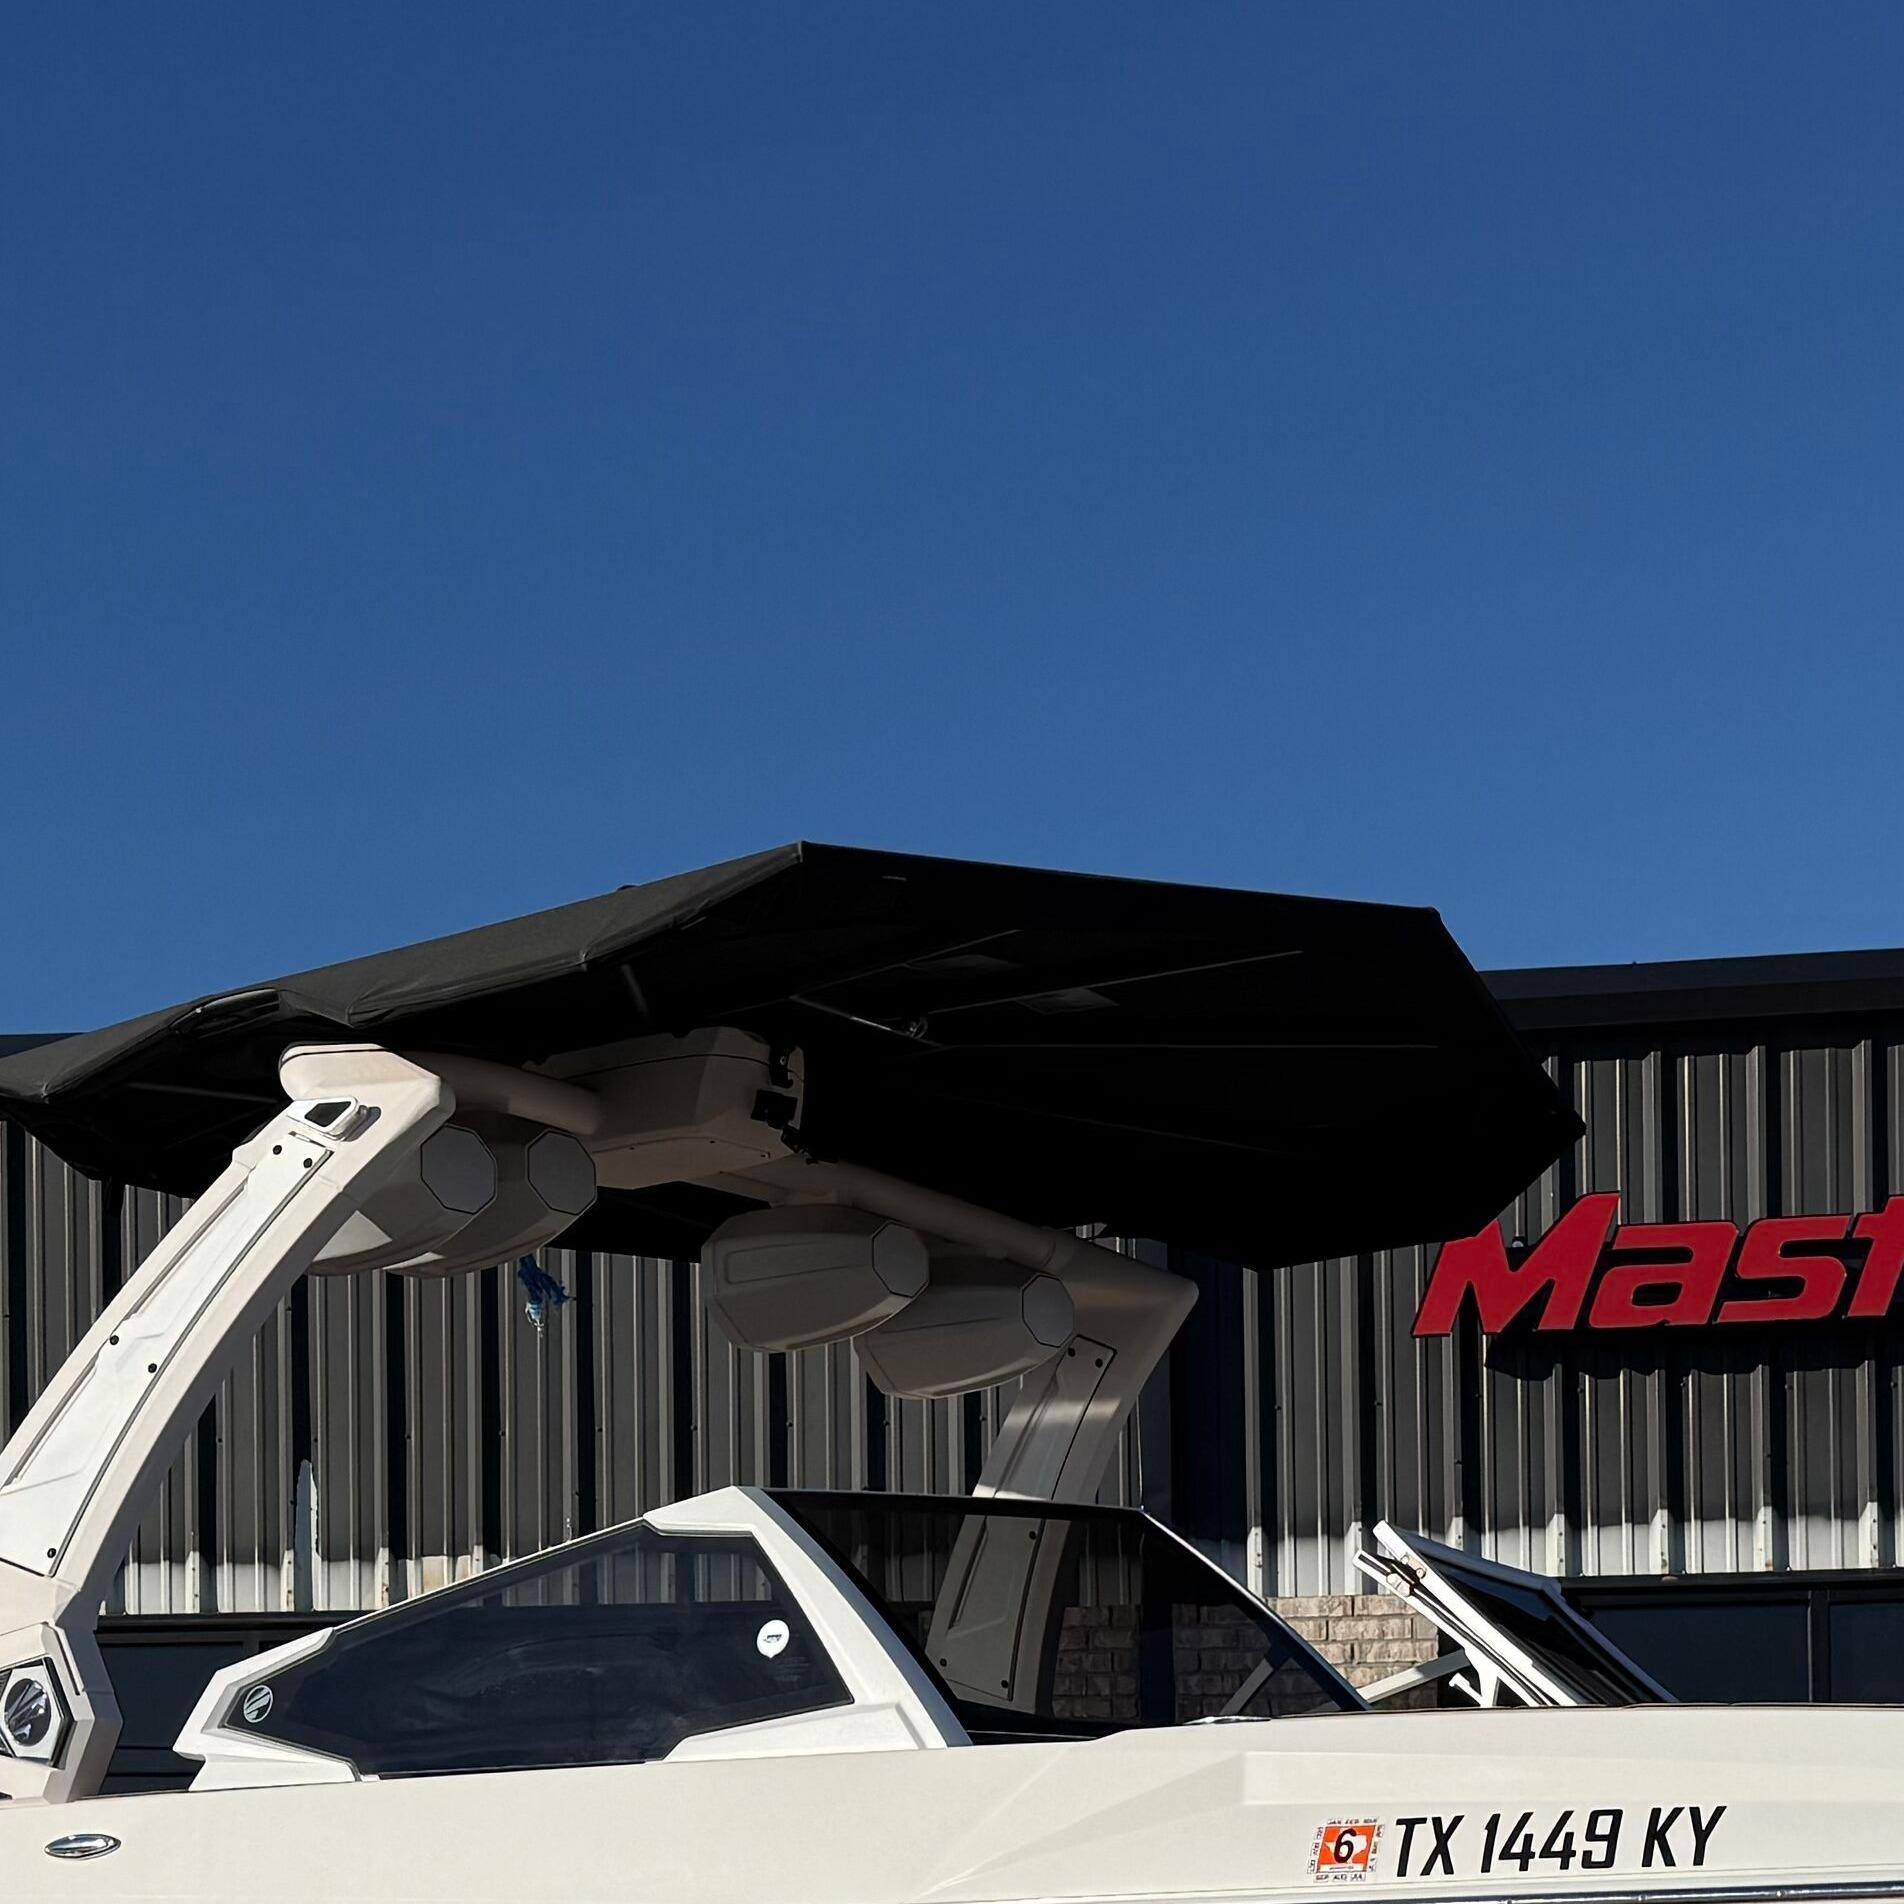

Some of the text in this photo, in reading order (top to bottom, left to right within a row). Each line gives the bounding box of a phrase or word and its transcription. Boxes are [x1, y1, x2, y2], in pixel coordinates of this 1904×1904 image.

[1333, 1827, 1358, 1864] 6
[1395, 1814, 1465, 1878] TX
[1480, 1808, 1625, 1874] 1449
[1641, 1805, 1728, 1868] KY
